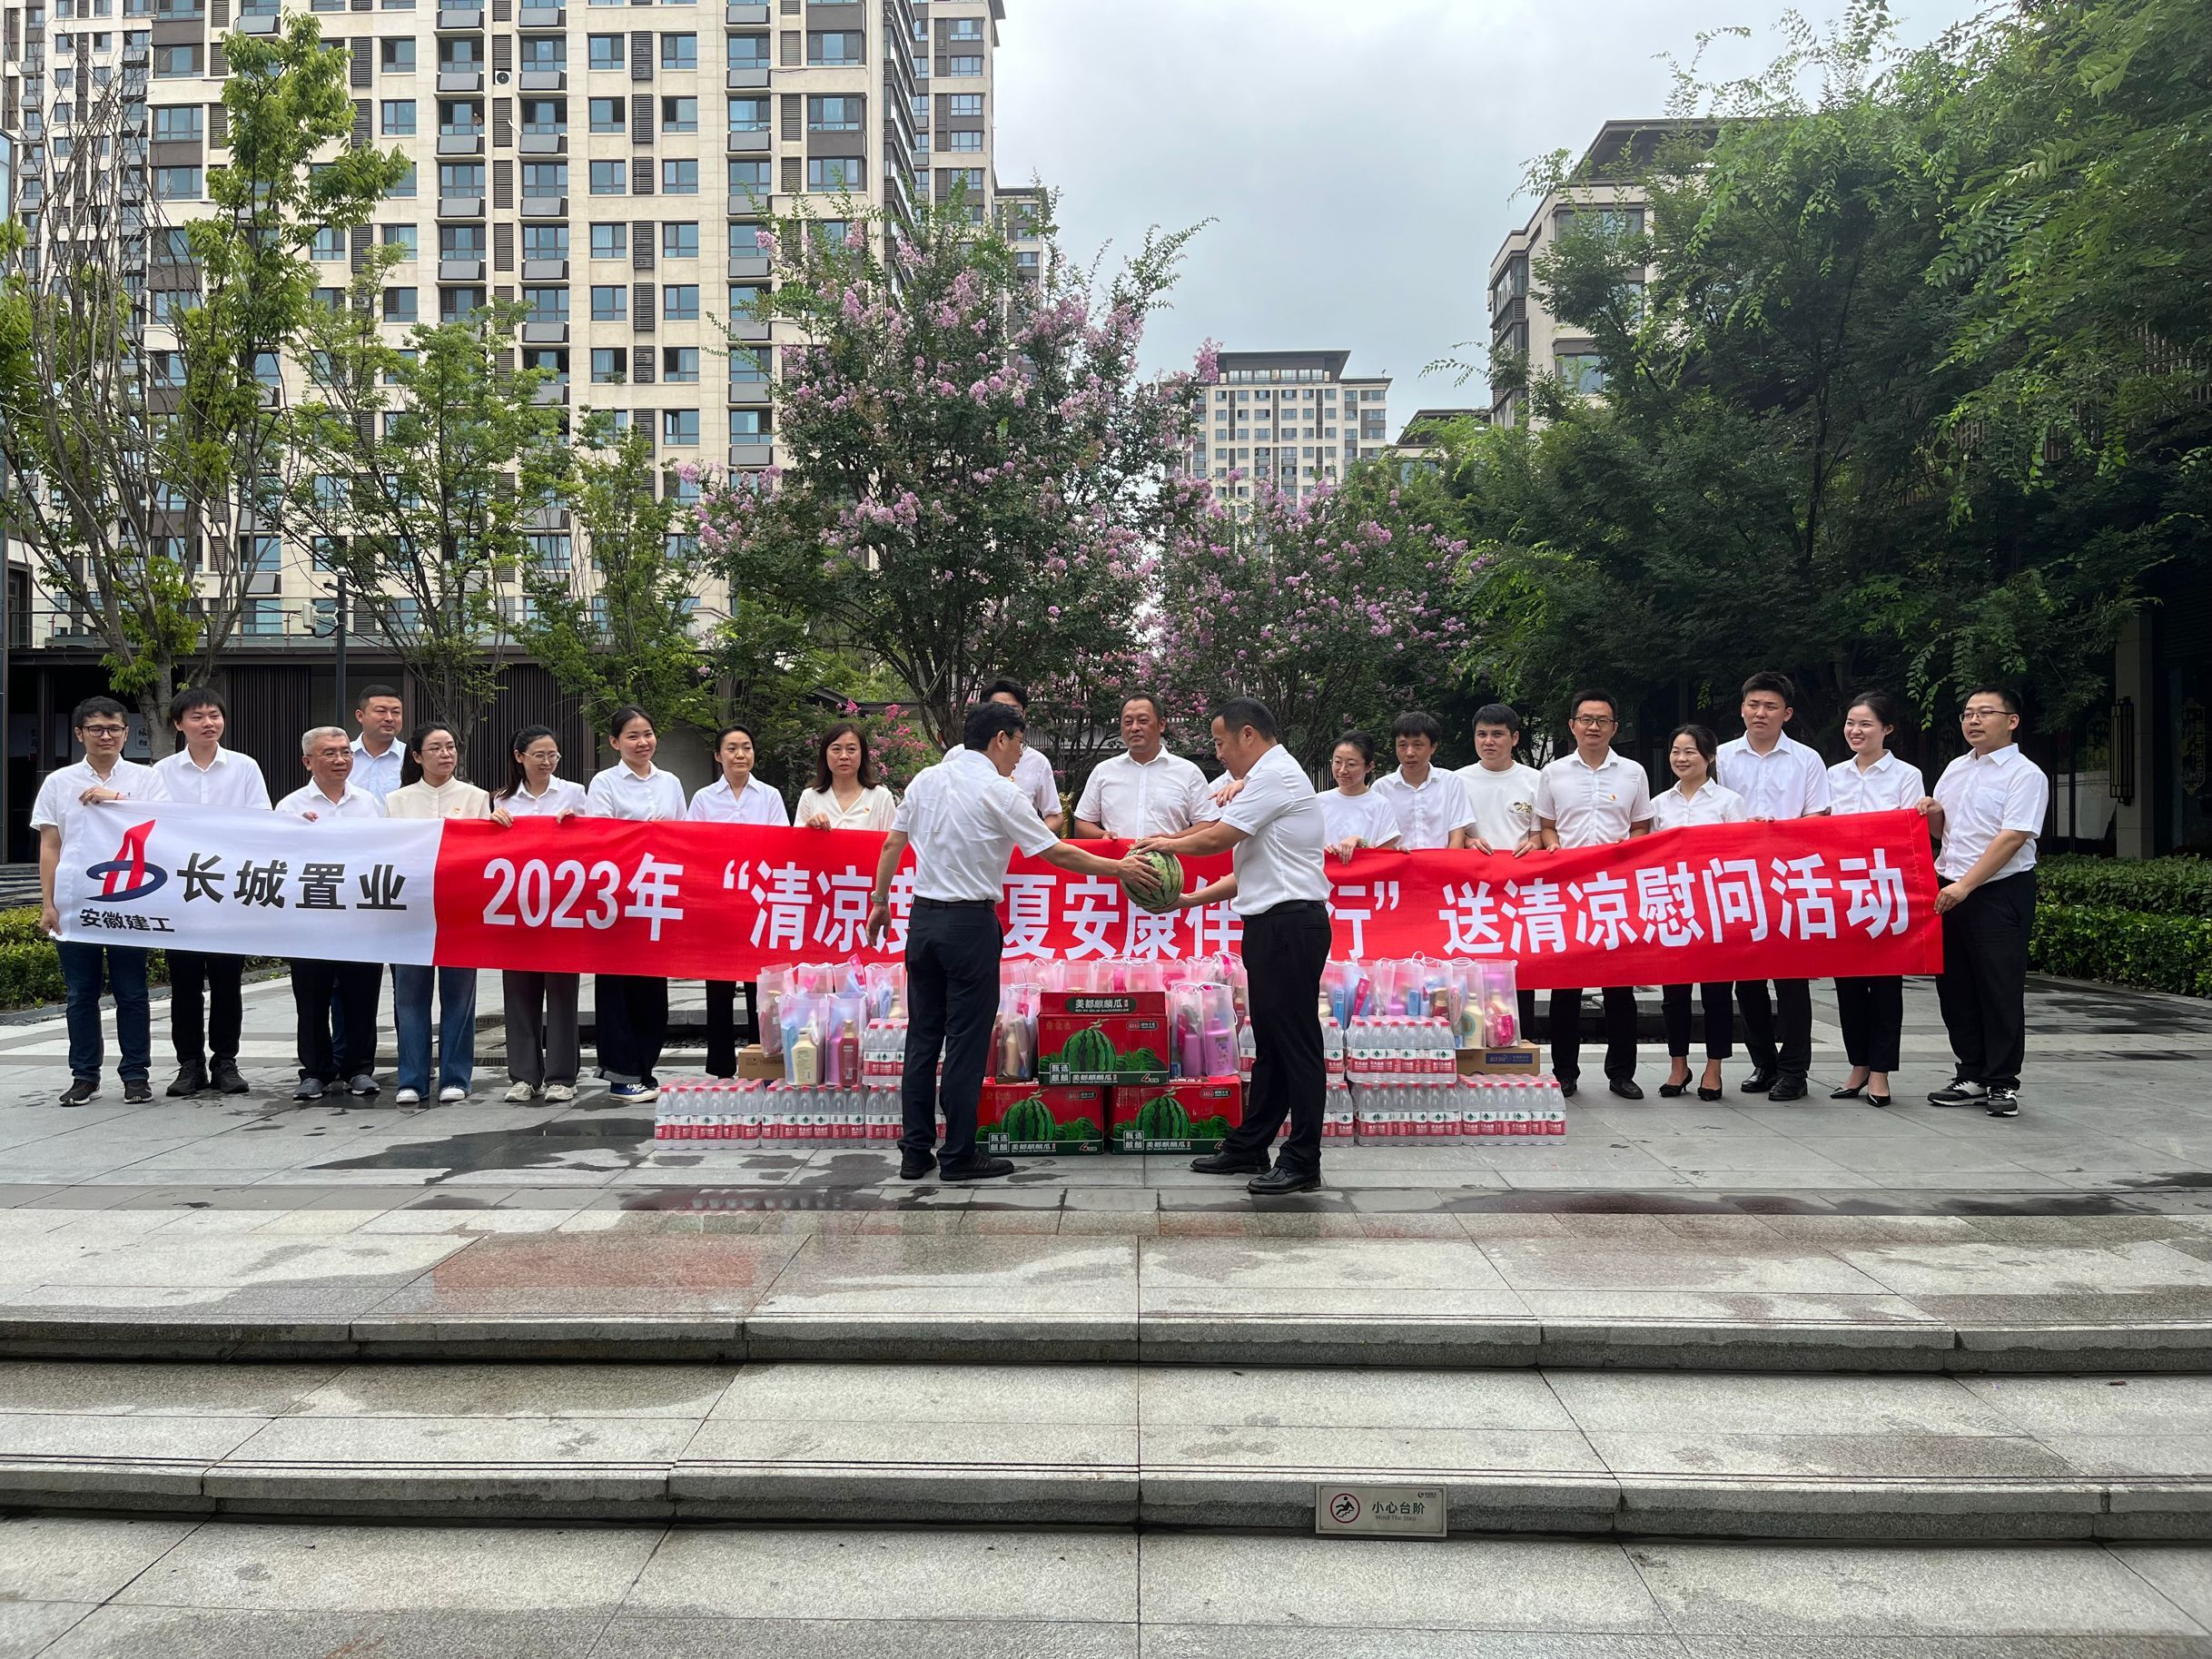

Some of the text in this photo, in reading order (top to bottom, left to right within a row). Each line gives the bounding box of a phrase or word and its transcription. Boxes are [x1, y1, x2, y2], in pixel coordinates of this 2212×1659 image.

[176, 852, 408, 911] 长城置业
[482, 852, 684, 941] 2023年
[1438, 848, 1909, 956] 送清凉慰问活动
[79, 908, 175, 933] 安徽建工
[1371, 1501, 1426, 1515] 小心台阶
